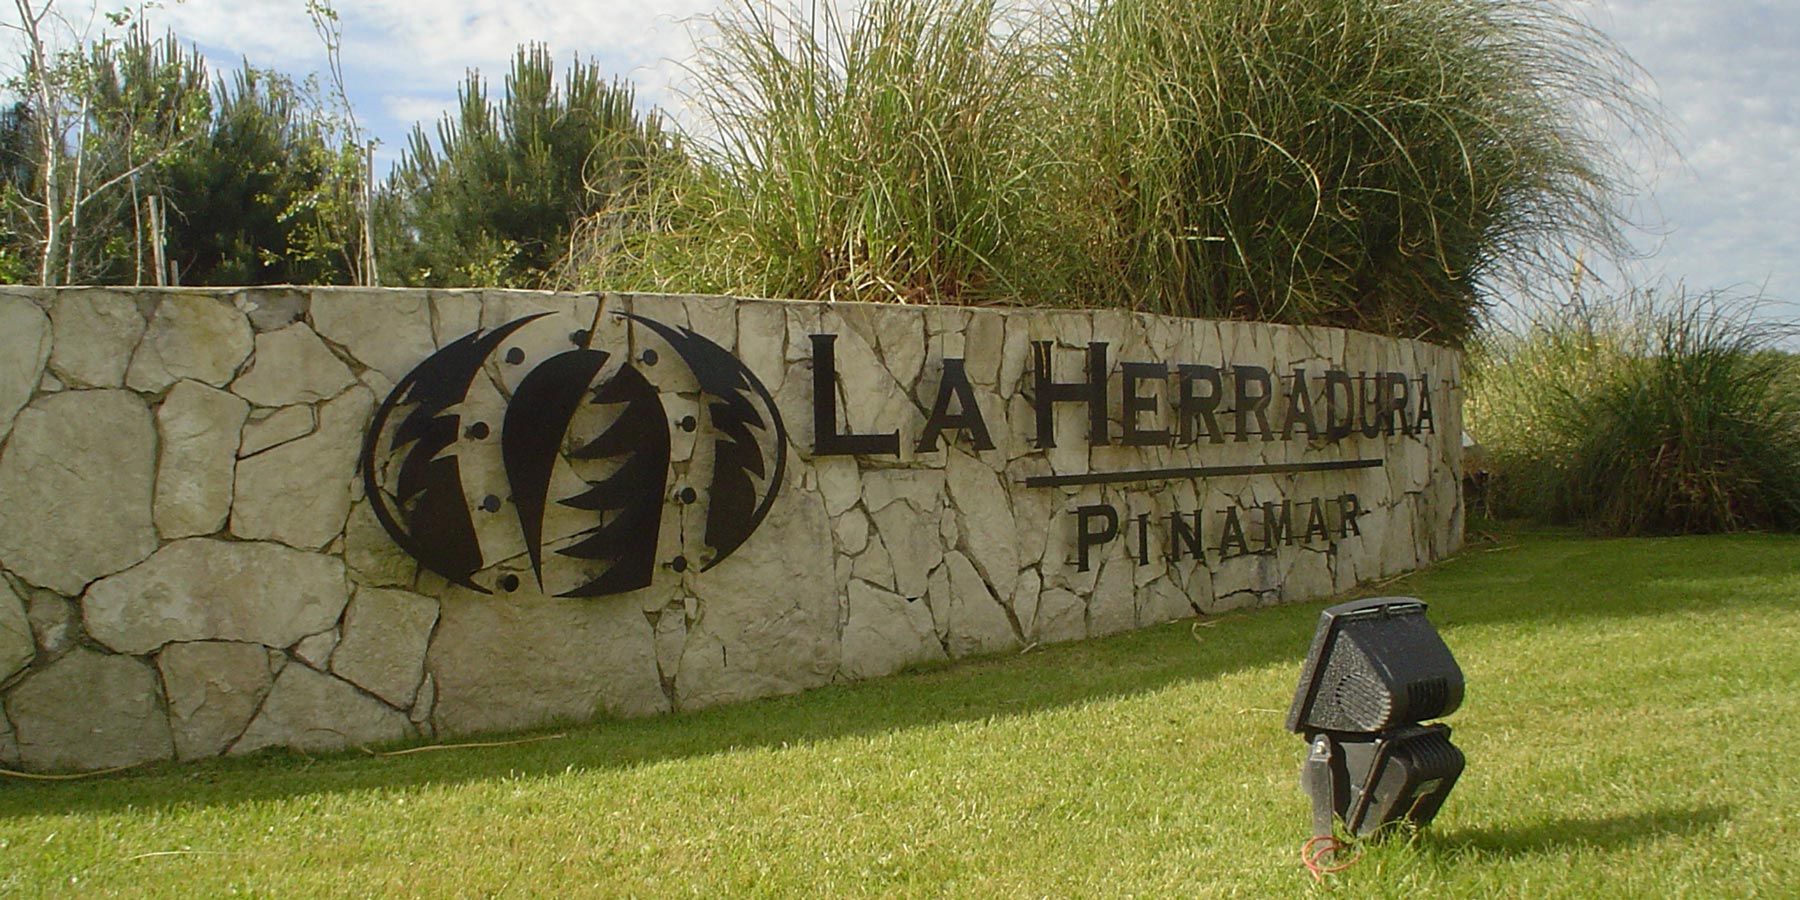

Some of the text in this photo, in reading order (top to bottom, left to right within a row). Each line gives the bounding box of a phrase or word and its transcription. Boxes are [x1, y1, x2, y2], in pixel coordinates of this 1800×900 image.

[809, 334, 1435, 457] LA HERRADURA
[1076, 493, 1361, 572] PINAMAR
